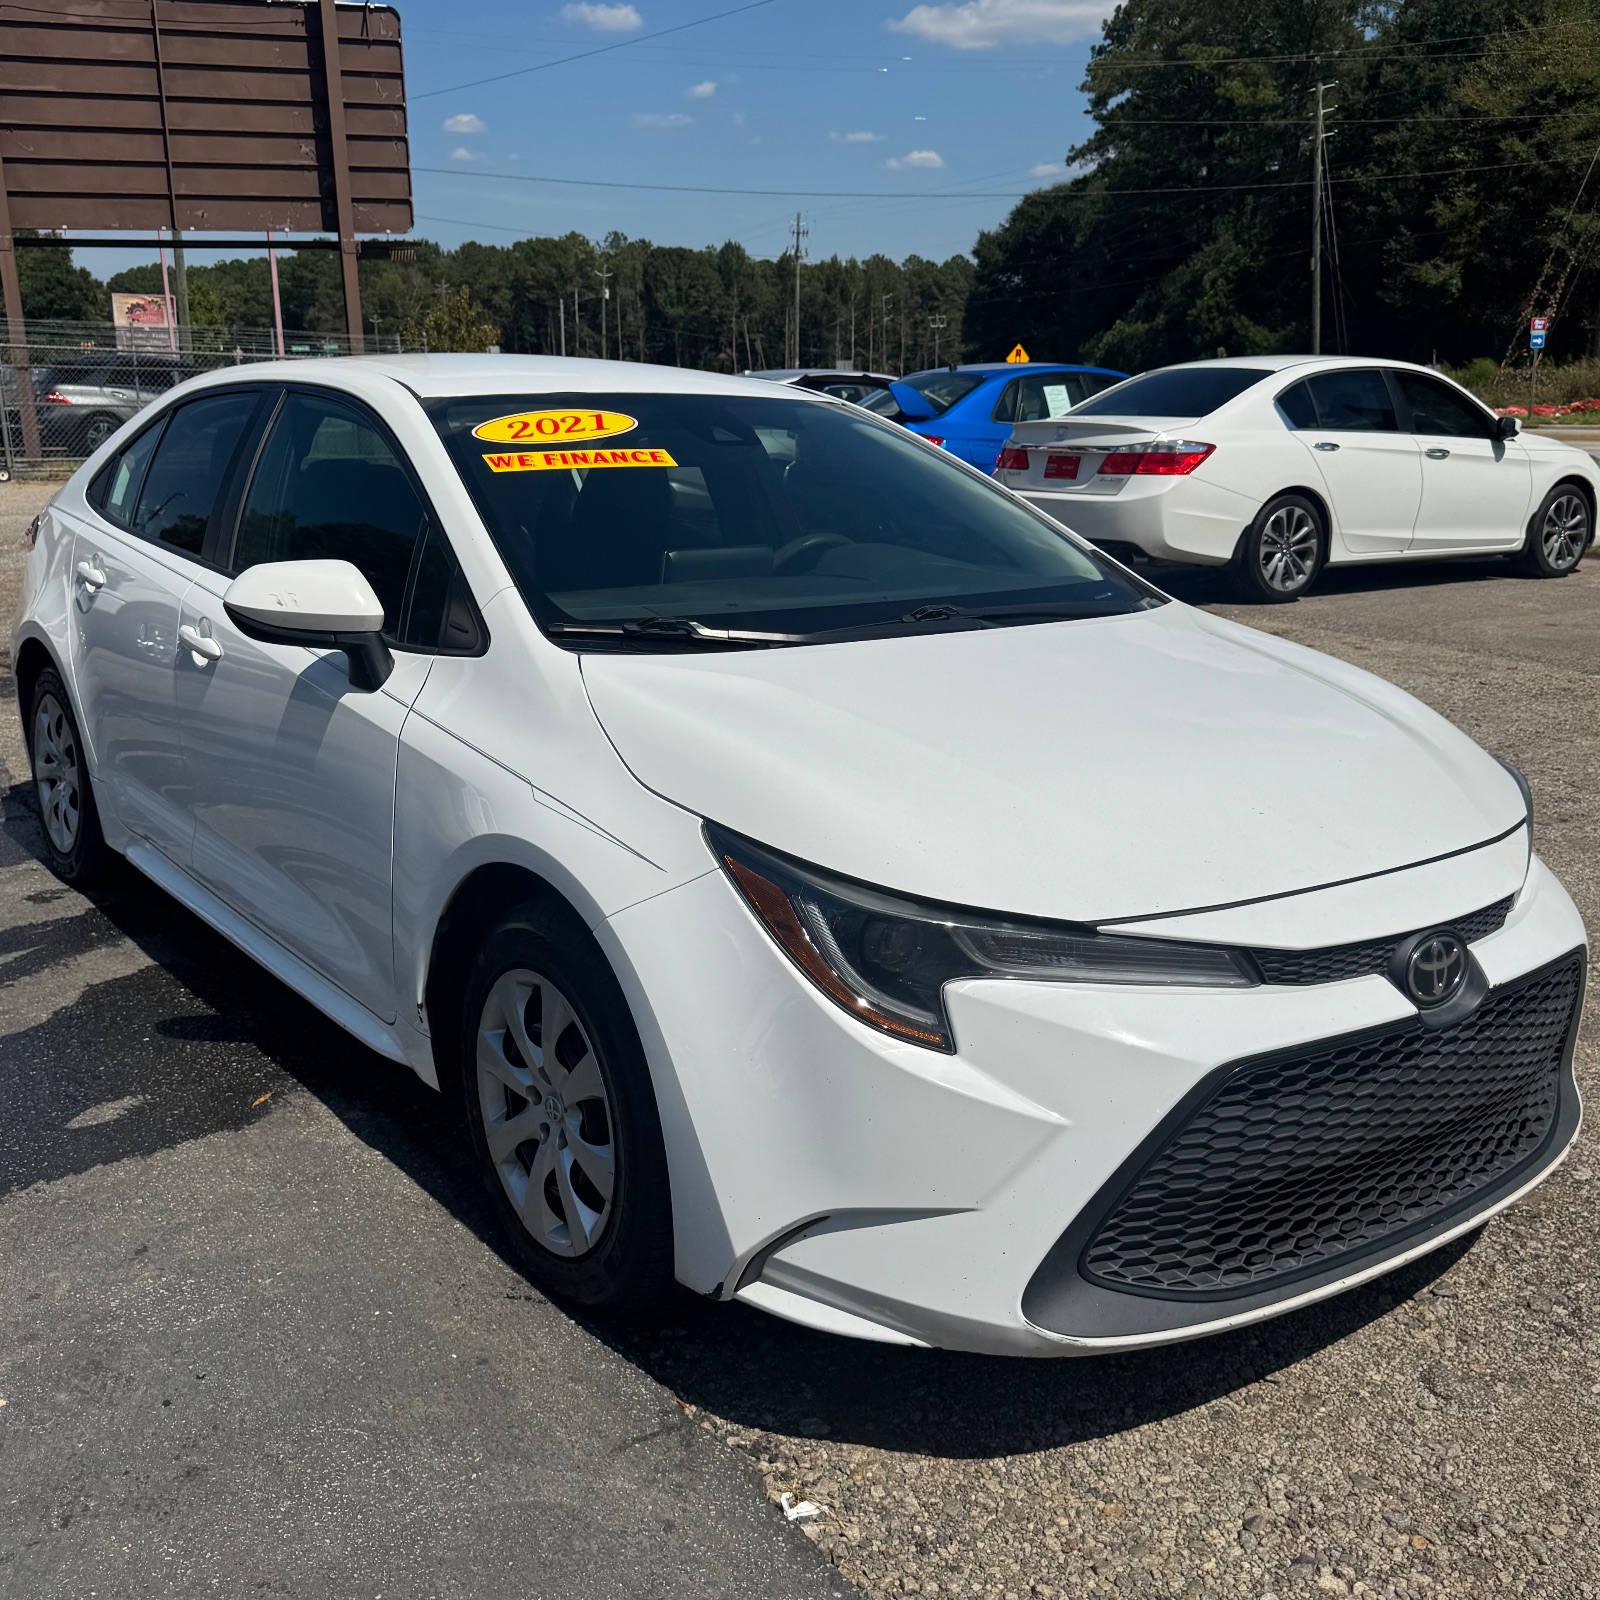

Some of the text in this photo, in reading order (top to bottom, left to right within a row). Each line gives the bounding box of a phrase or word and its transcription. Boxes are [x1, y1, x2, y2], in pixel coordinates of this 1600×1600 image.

[507, 414, 610, 439] 2021
[487, 451, 665, 469] WE FINANCE
